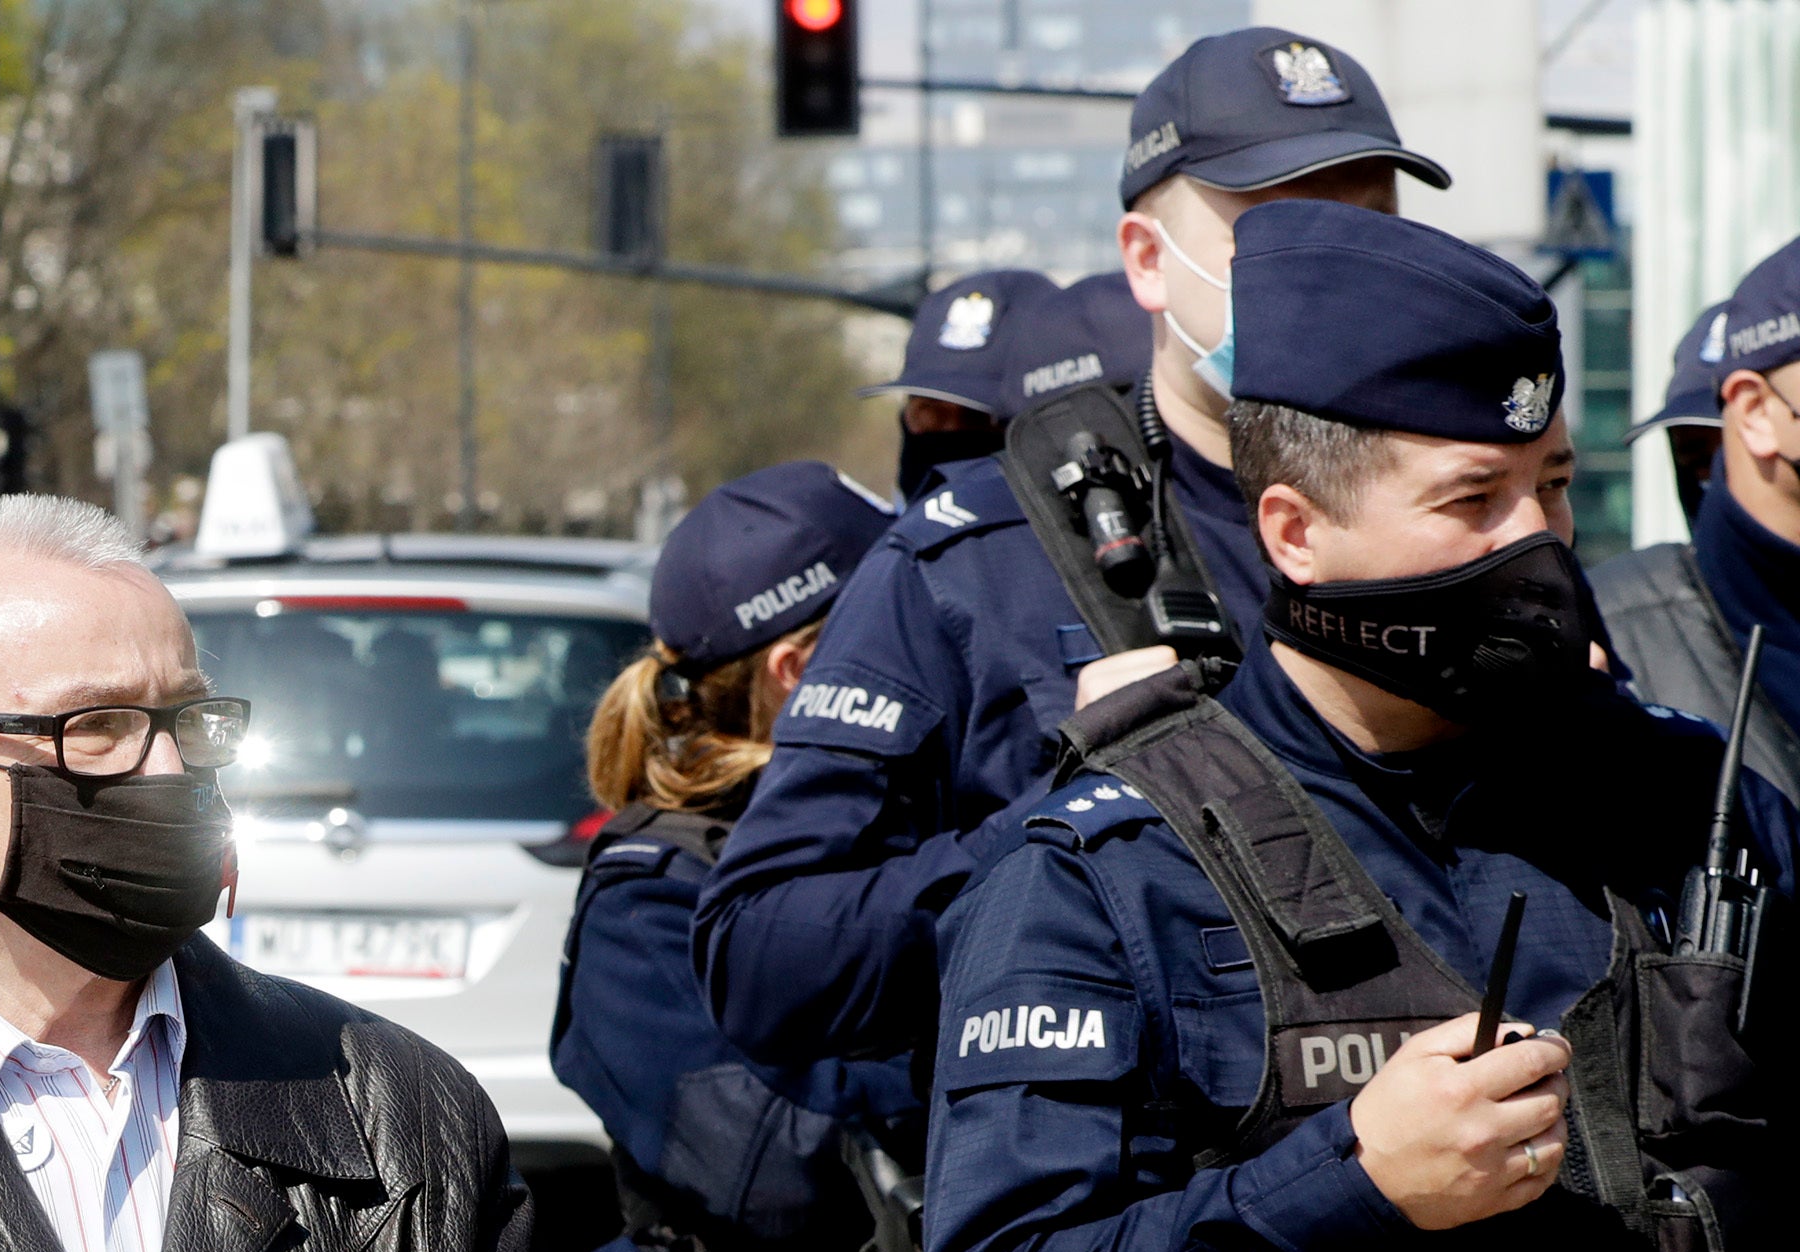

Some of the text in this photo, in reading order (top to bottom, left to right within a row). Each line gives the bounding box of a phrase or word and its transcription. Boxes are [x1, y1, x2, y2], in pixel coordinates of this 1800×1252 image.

[1023, 353, 1104, 398] POLICJA
[734, 561, 838, 630] POLICJA
[1289, 599, 1437, 657] REFLECT
[789, 683, 904, 733] POLICJA
[959, 1005, 1106, 1058] POLICJA
